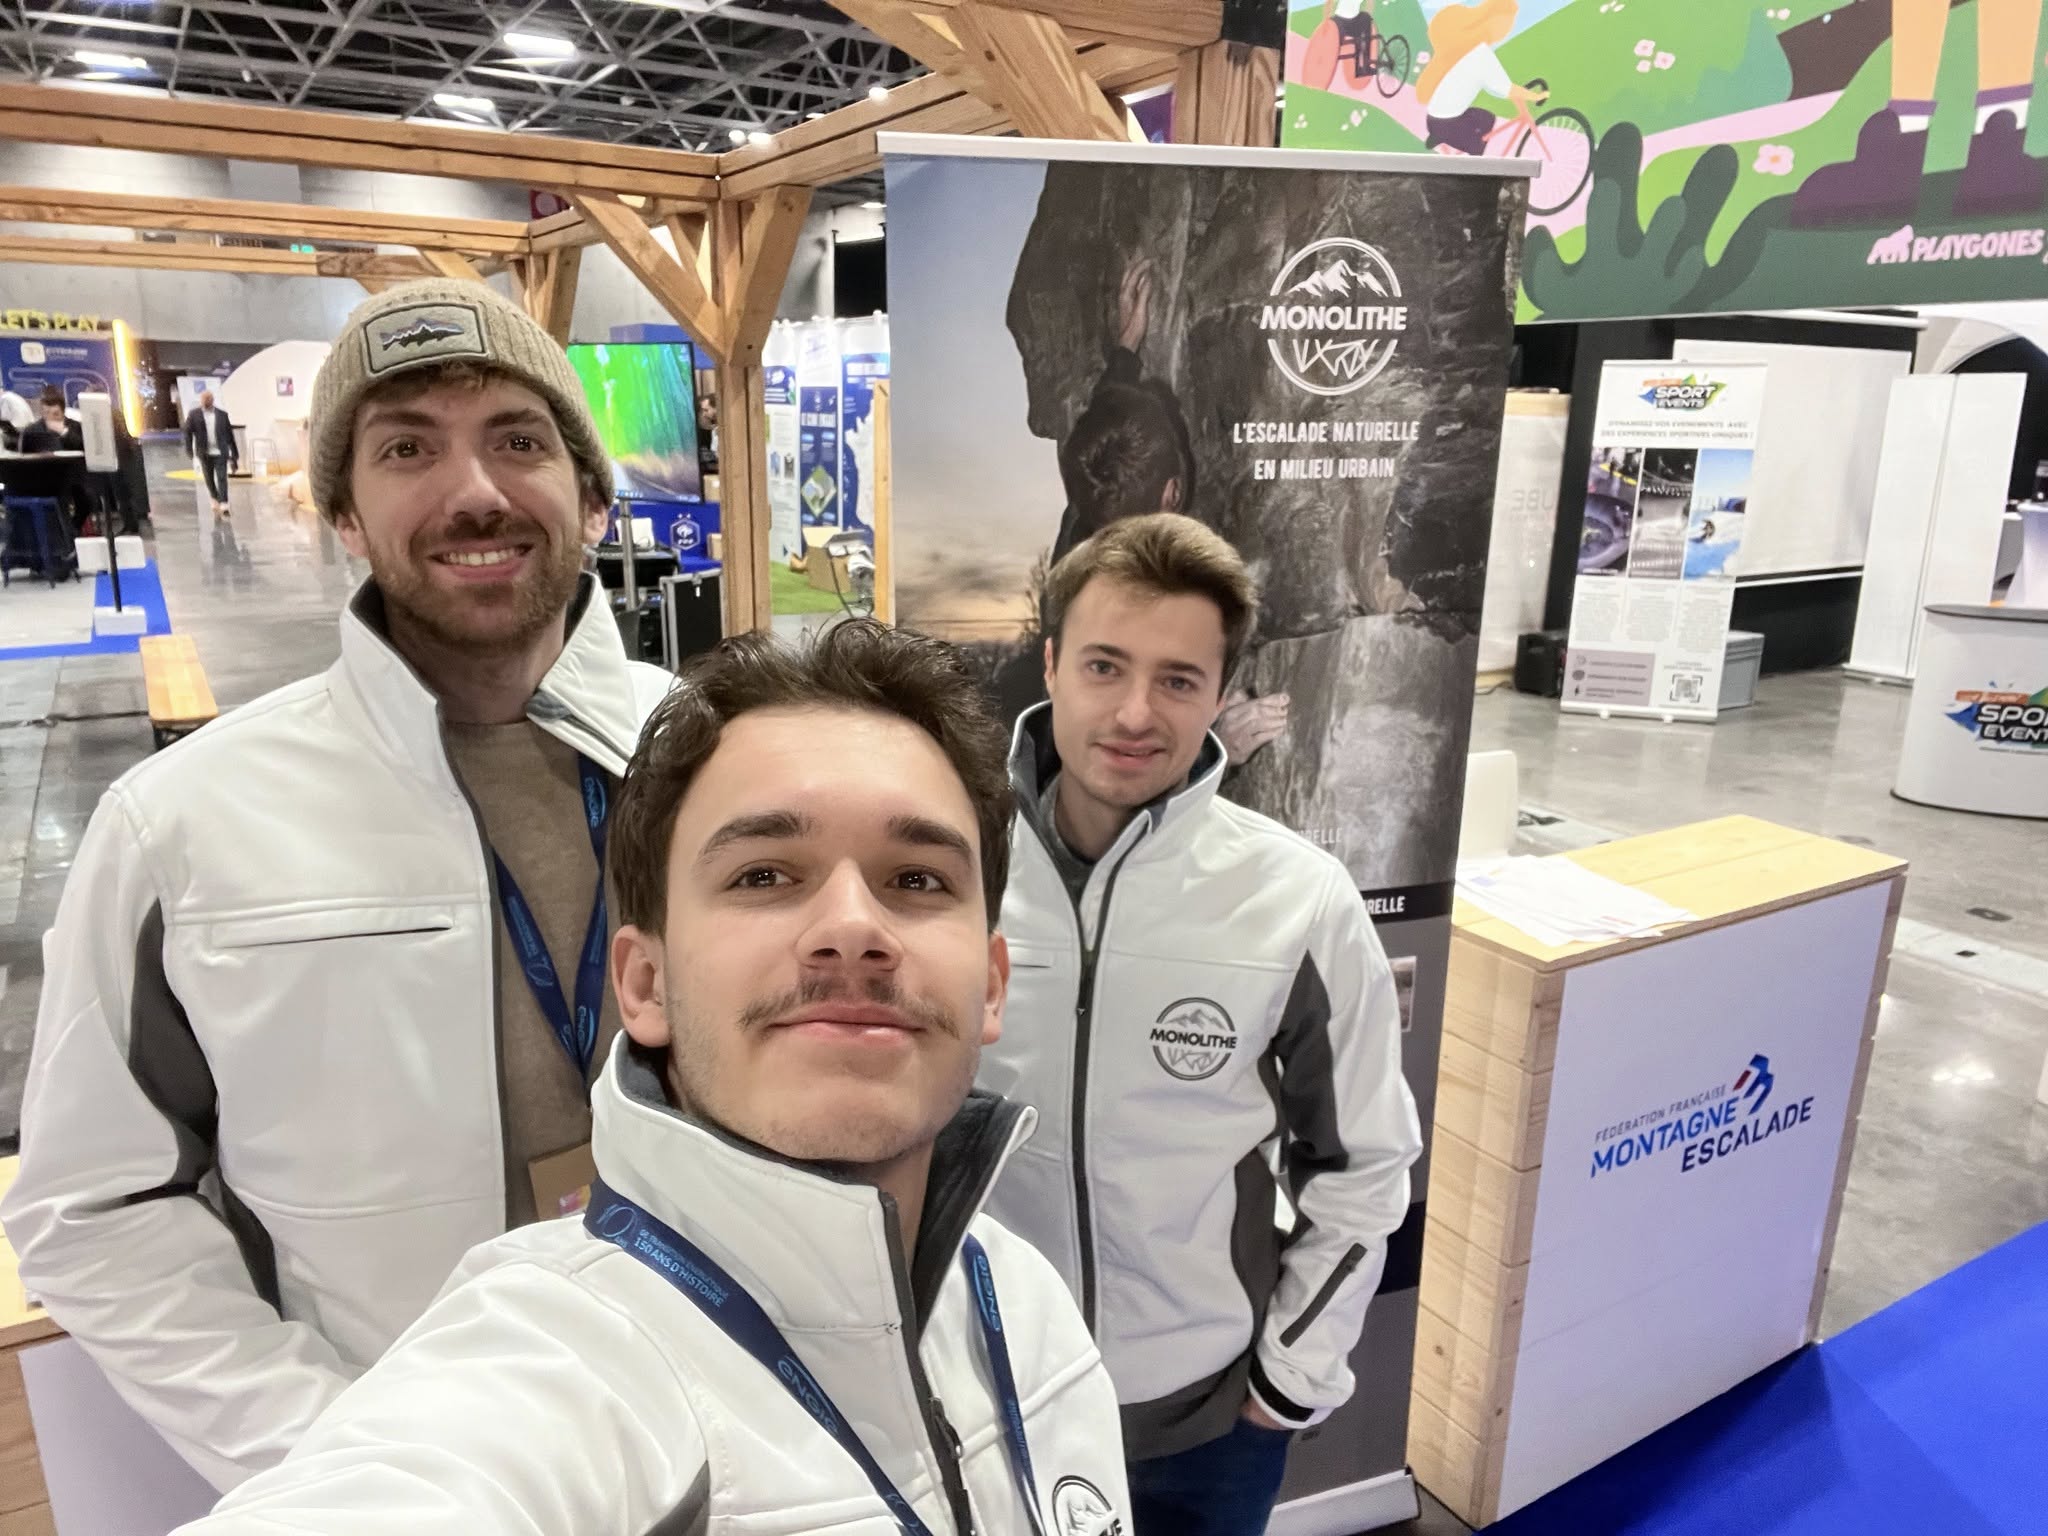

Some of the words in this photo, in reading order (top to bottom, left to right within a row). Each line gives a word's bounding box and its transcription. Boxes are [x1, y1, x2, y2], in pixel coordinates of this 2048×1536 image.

[1912, 229, 2044, 262] PLAYGONES
[54, 312, 99, 333] PLAY
[1260, 305, 1408, 330] MONOLITHE
[1654, 385, 1716, 400] SPORT
[1656, 399, 1706, 409] EVENTS
[1233, 422, 1328, 444] L'ESCALADE
[1332, 421, 1420, 442] NATURELLE
[1254, 459, 1277, 480] EN
[1280, 458, 1334, 479] MILIEU
[1338, 457, 1396, 478] URBAIN
[1978, 704, 2048, 727] SPO
[1149, 1028, 1238, 1049] MONOLITHE
[1669, 1083, 1727, 1114] FRANÇAISE
[1590, 1096, 1739, 1179] MONTAGNE
[1680, 1096, 1815, 1173] ESCALADE
[634, 1236, 654, 1254] 150
[649, 1249, 674, 1268] ANS
